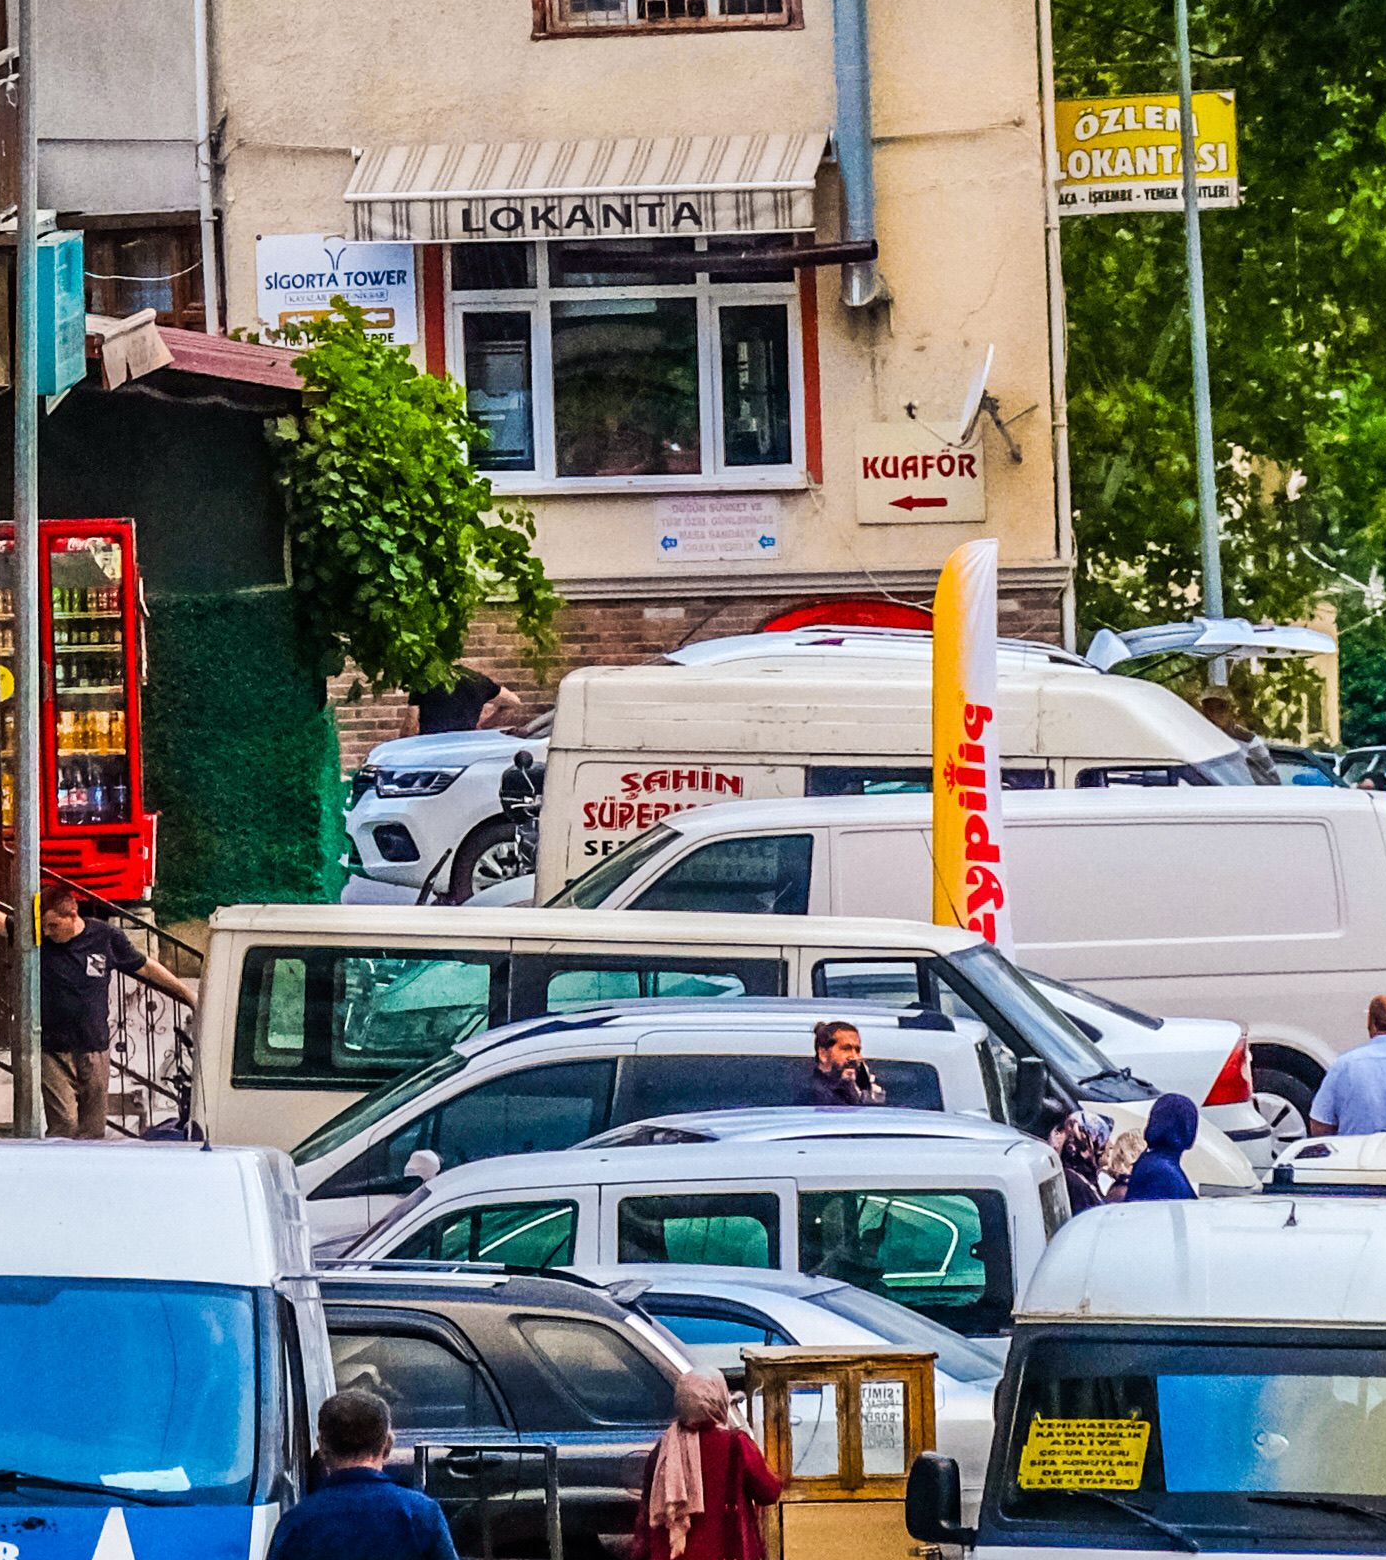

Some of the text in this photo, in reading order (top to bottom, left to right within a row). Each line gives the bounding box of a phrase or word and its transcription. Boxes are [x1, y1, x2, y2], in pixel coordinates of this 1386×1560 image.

[1054, 142, 1229, 180] LOKANTSI
[462, 202, 703, 233] LOKANTA
[344, 269, 407, 288] TOWER
[862, 448, 978, 480] KUAFÖR
[620, 766, 744, 801] ŞAHİN
